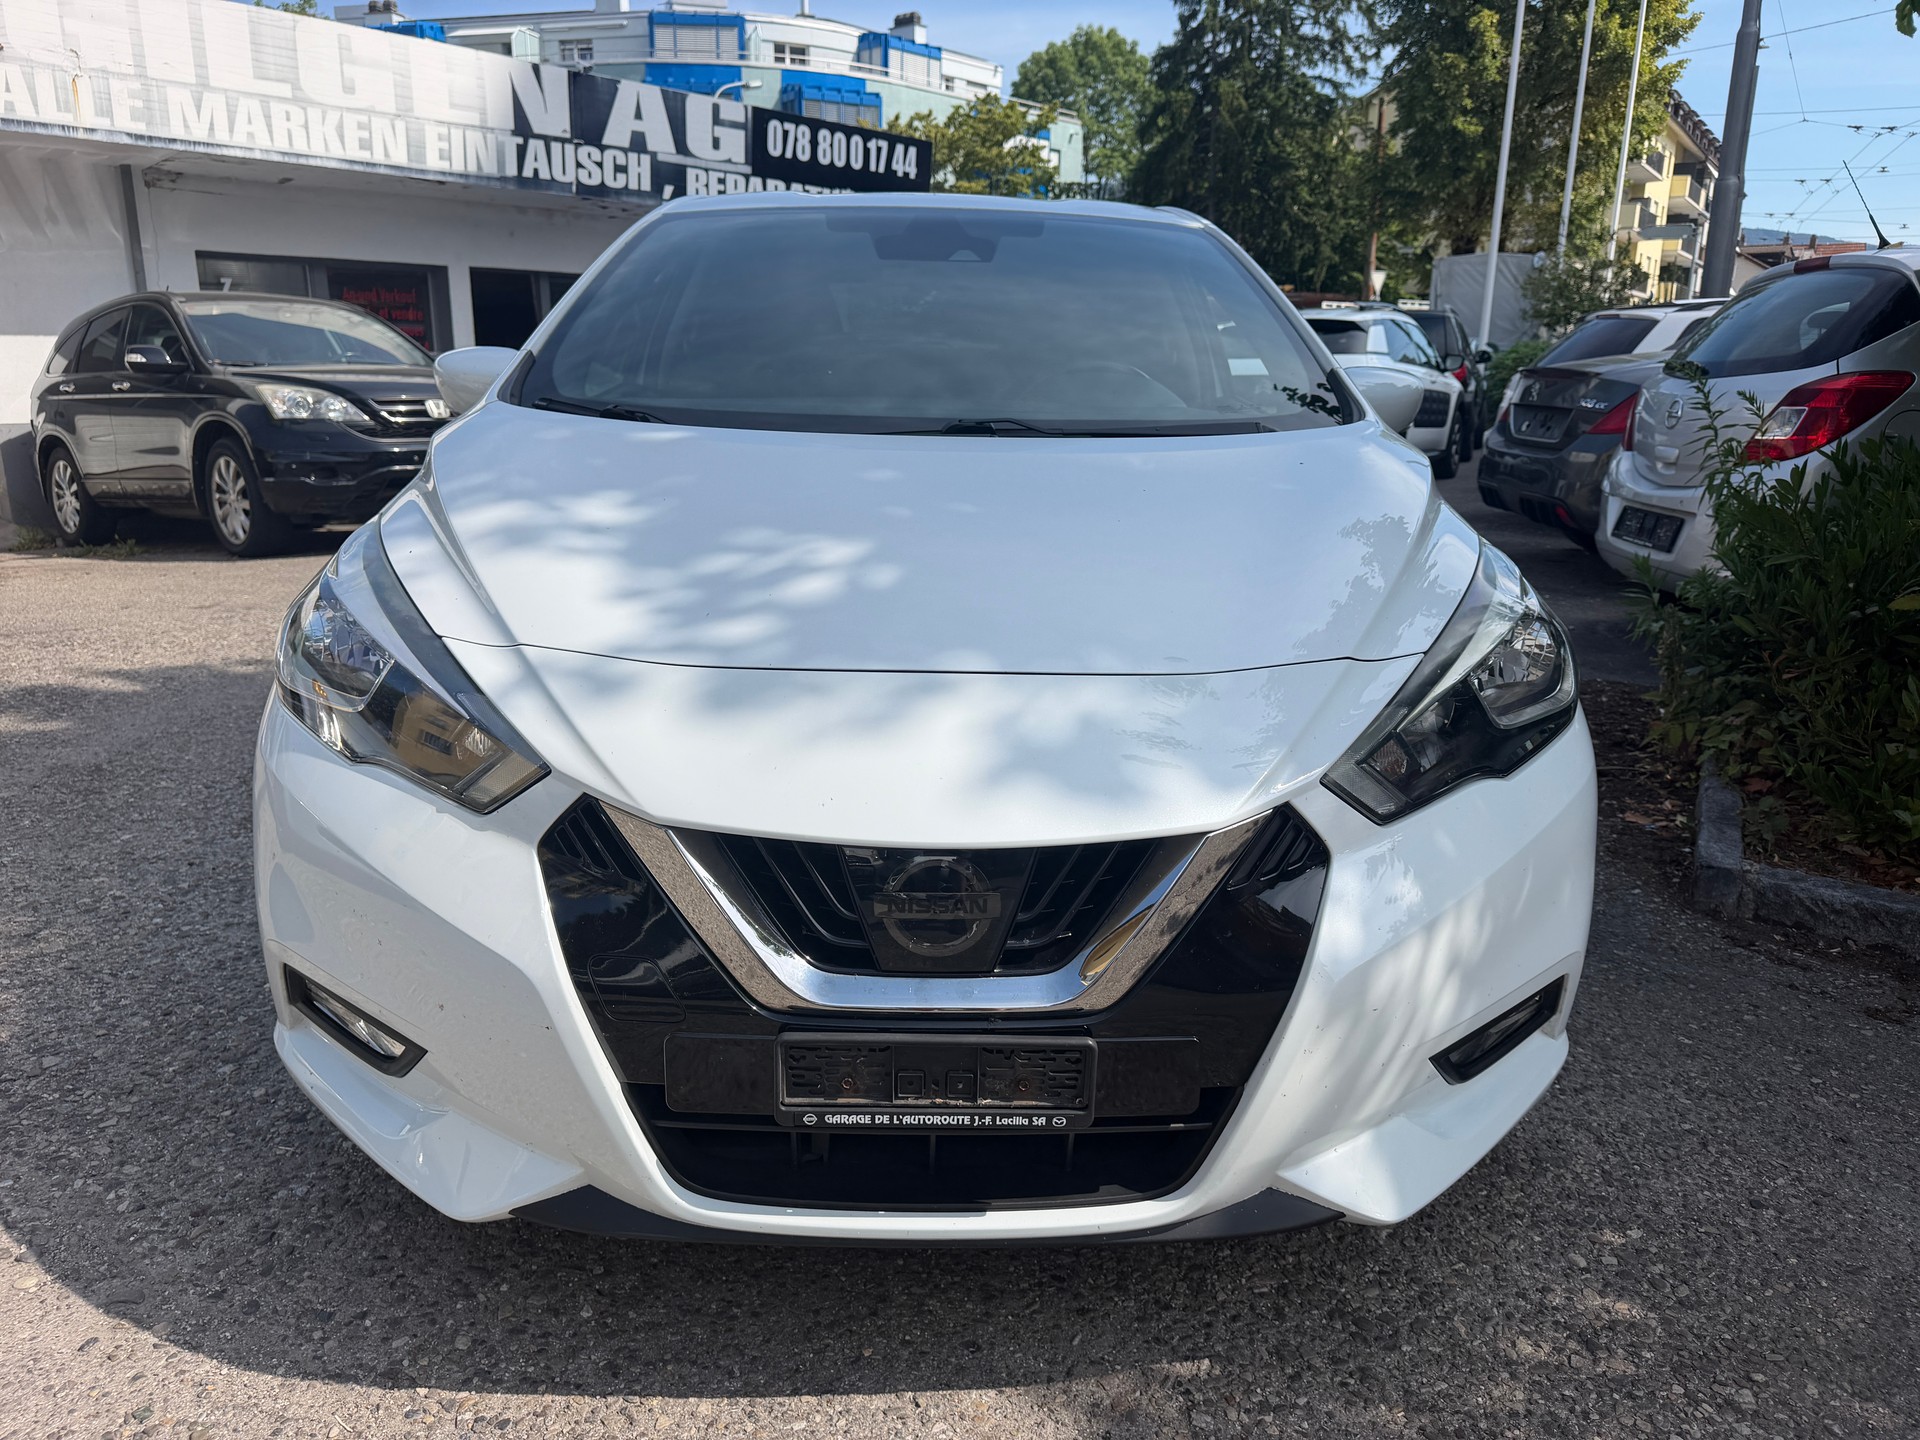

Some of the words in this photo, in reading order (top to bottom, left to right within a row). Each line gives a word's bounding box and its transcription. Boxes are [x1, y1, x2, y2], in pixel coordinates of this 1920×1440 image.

[0, 63, 147, 131] ALLE
[167, 90, 408, 163] MARKEN
[424, 122, 652, 192] EINTAUSCH
[601, 80, 747, 164] AG
[766, 119, 811, 162] 078
[890, 144, 918, 180] 44
[887, 899, 988, 915] NISSAN
[824, 1114, 872, 1125] GARAGE
[874, 1114, 890, 1124] DE
[893, 1114, 971, 1126] L'AUTOROUTE
[973, 1115, 993, 1127] J.-F.
[1032, 1116, 1047, 1127] SA
